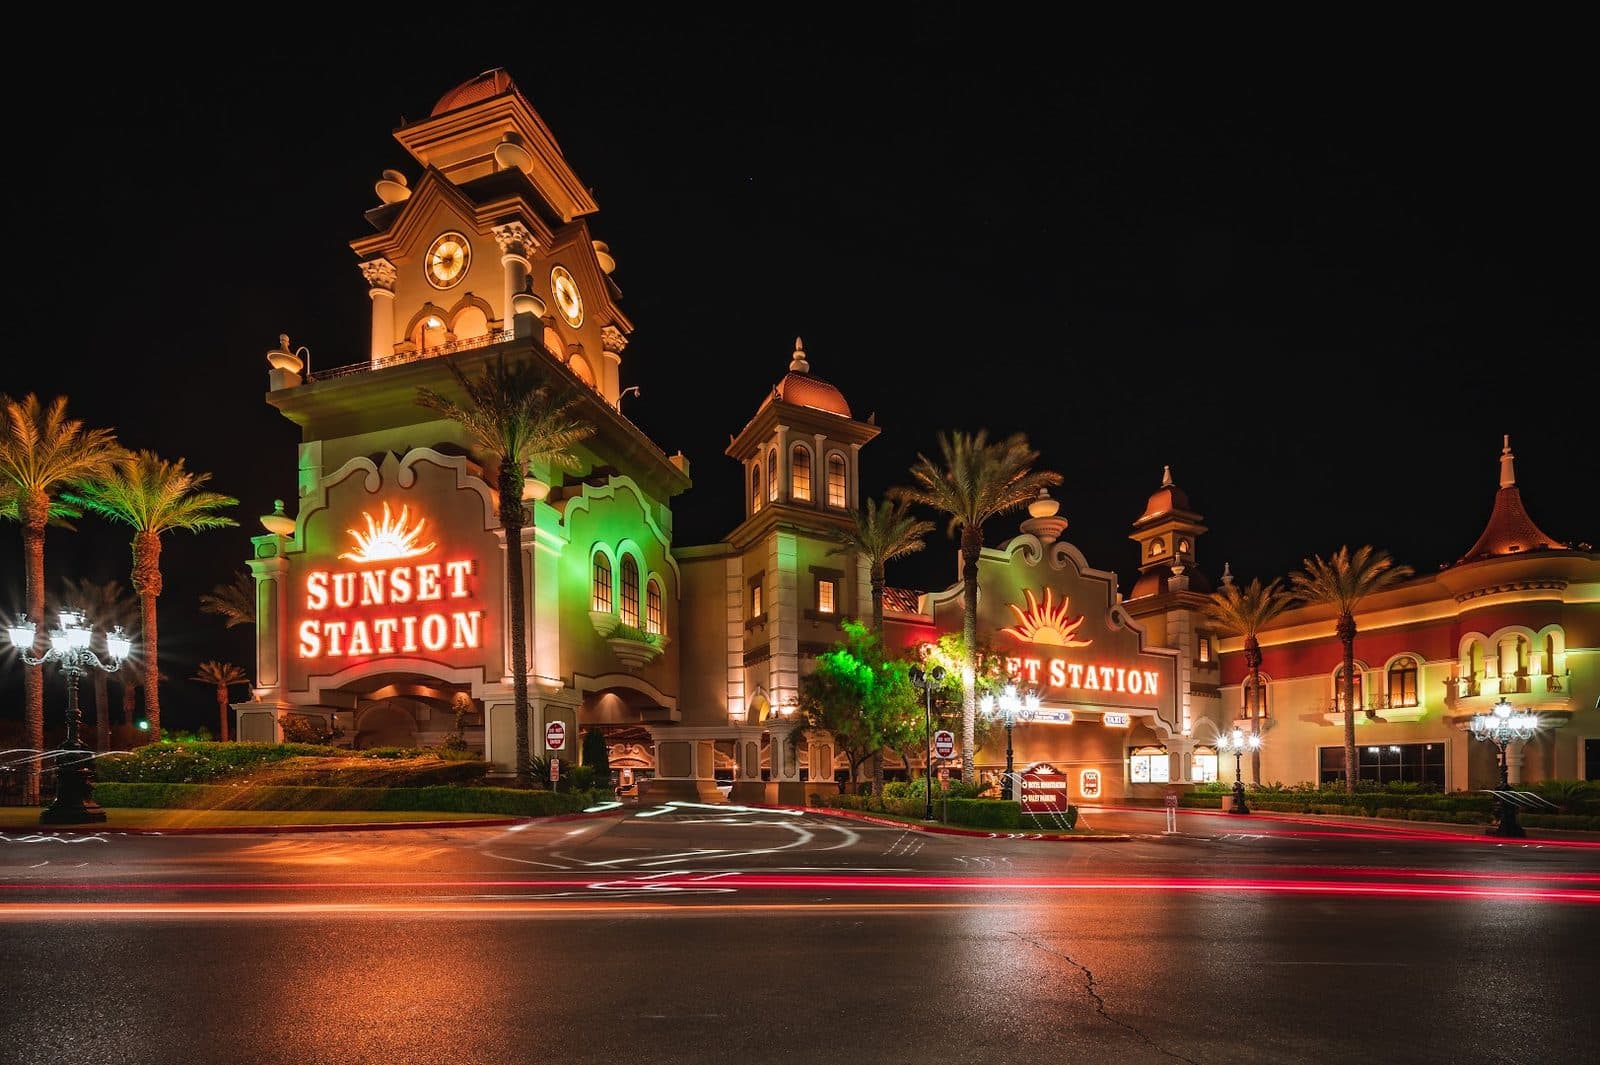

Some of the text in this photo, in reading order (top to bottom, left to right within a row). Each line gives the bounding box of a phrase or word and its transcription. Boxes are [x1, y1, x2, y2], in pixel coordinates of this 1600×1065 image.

[307, 561, 472, 610] SUNSET
[299, 611, 481, 659] STATION
[1049, 658, 1160, 696] STATION
[1106, 716, 1121, 725] TAXI
